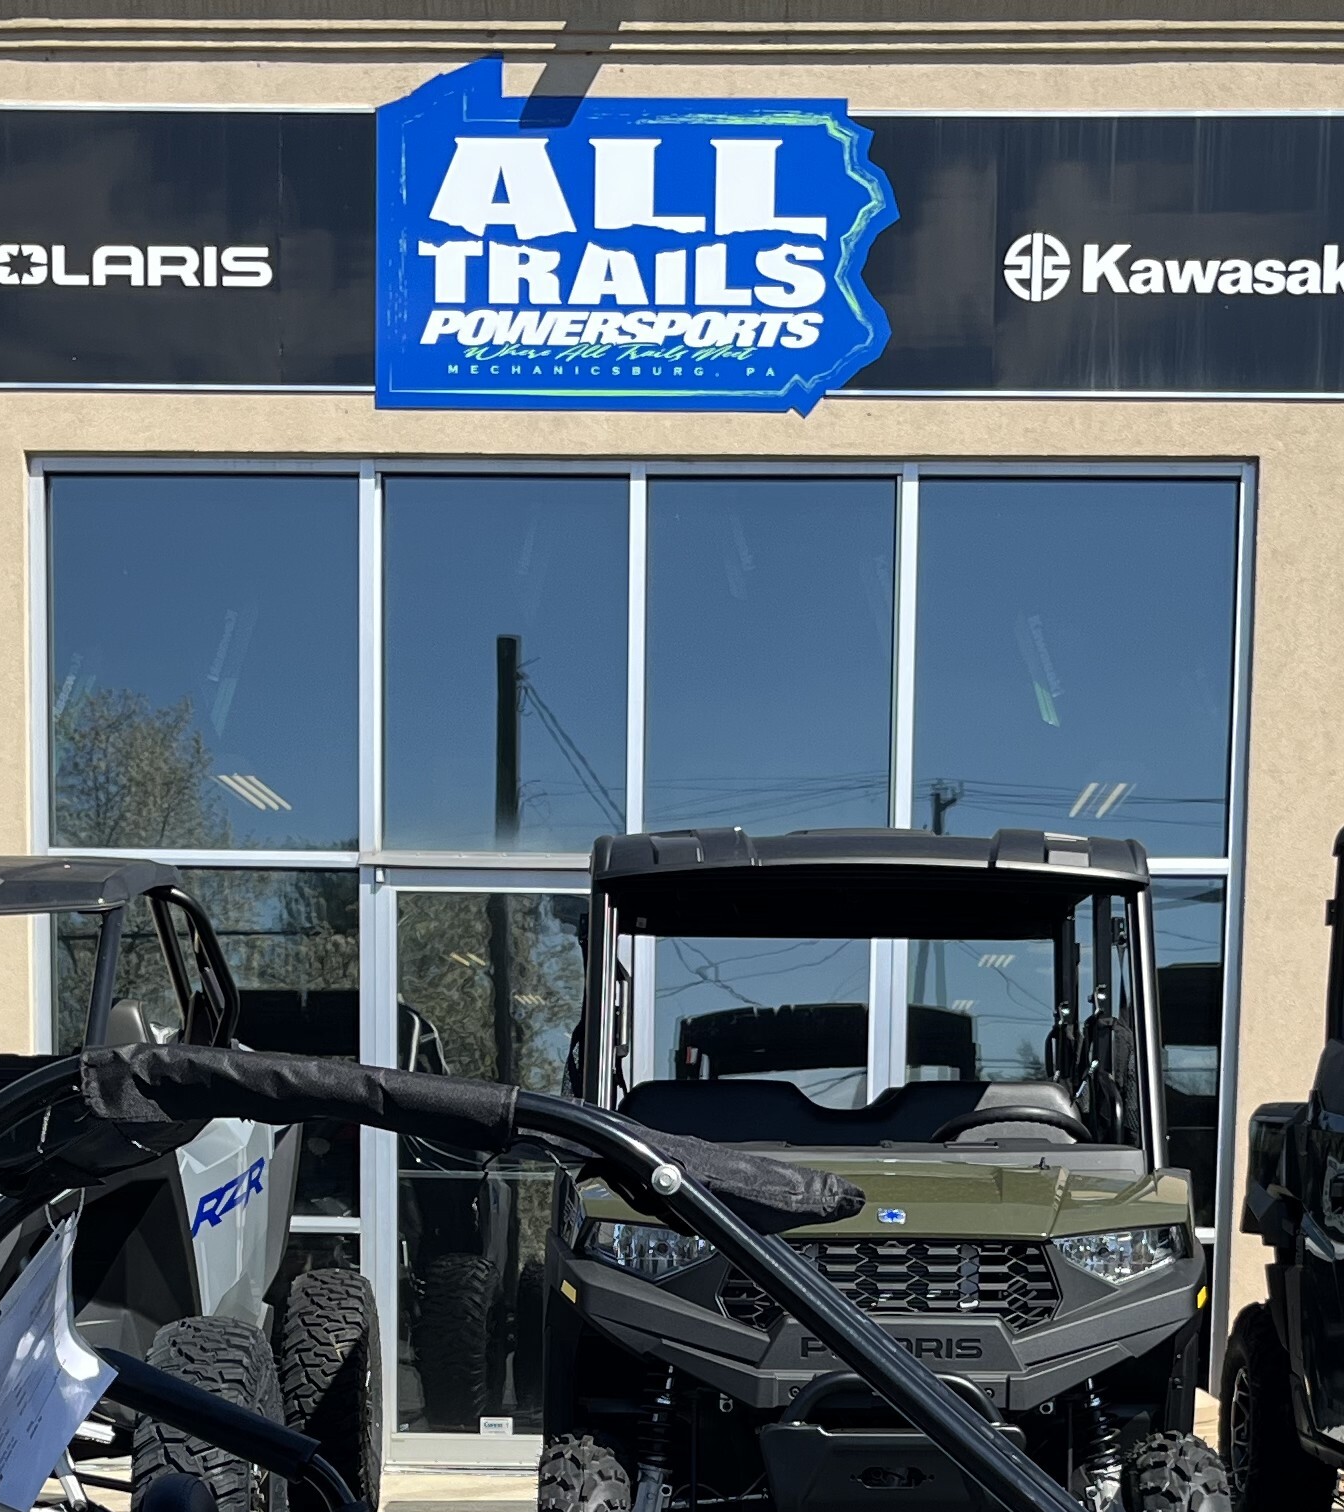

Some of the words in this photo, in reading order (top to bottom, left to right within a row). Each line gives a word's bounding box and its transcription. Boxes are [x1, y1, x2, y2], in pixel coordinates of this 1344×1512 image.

[428, 136, 828, 241] ALL
[418, 239, 827, 308] TRAILS
[419, 309, 824, 349] POWERSPORTS
[463, 342, 551, 363] Where
[556, 342, 607, 363] All
[616, 341, 689, 363] Trails
[746, 366, 776, 378] PA
[191, 1156, 265, 1240] RZR
[800, 1336, 984, 1360] PARIS
